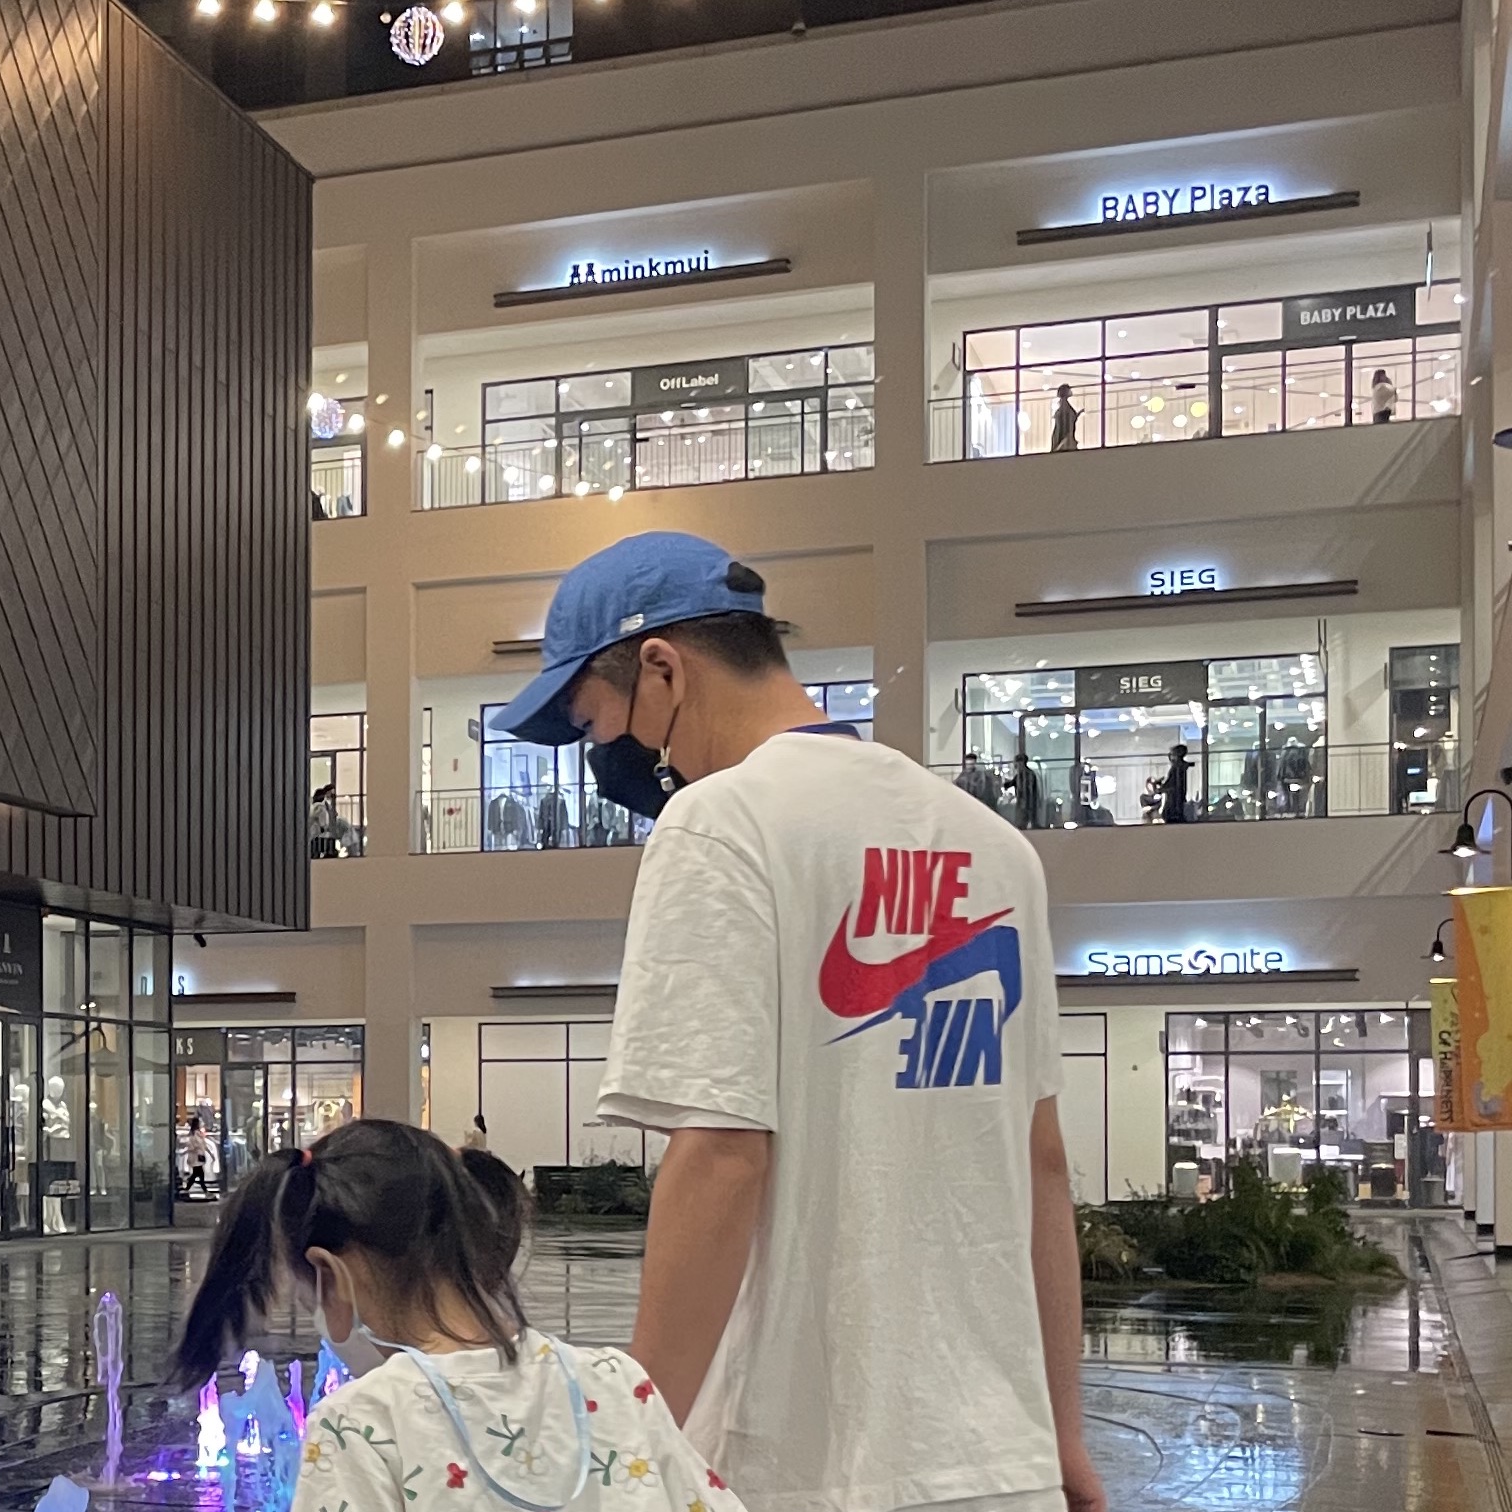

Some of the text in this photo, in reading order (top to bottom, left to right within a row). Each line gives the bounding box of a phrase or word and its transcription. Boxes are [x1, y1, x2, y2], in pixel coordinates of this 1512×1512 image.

[1102, 184, 1270, 223] BABY Plaza
[601, 249, 709, 283] minkmui
[1300, 302, 1396, 325] BABY PLAZA
[1150, 568, 1216, 588] SIEG
[1119, 675, 1162, 690] SIEG
[852, 847, 973, 938] NIKE
[1088, 948, 1284, 976] Samsonite
[894, 998, 1004, 1090] NIKE
